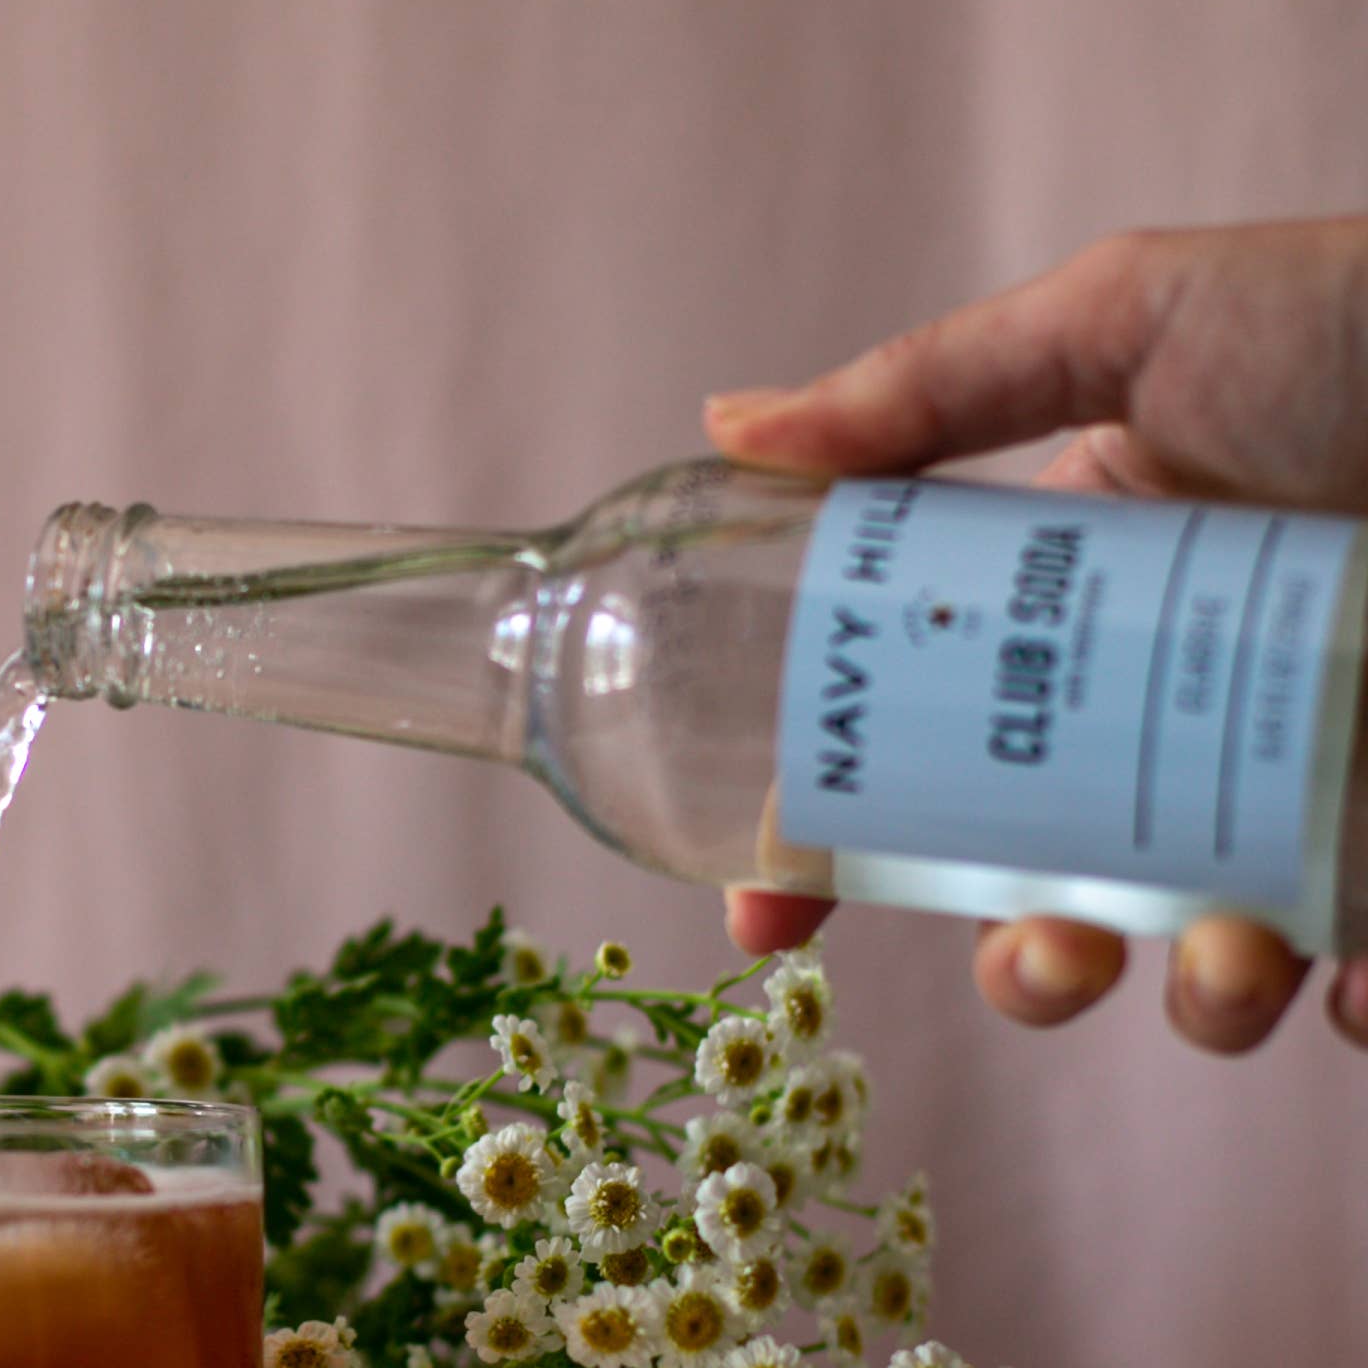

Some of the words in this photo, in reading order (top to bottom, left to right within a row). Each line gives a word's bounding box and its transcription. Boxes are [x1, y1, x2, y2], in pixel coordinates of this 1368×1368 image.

[842, 484, 921, 583] HILL
[1009, 525, 1084, 626] SODA
[817, 605, 878, 794] NAVY
[987, 638, 1057, 766] CLUB
